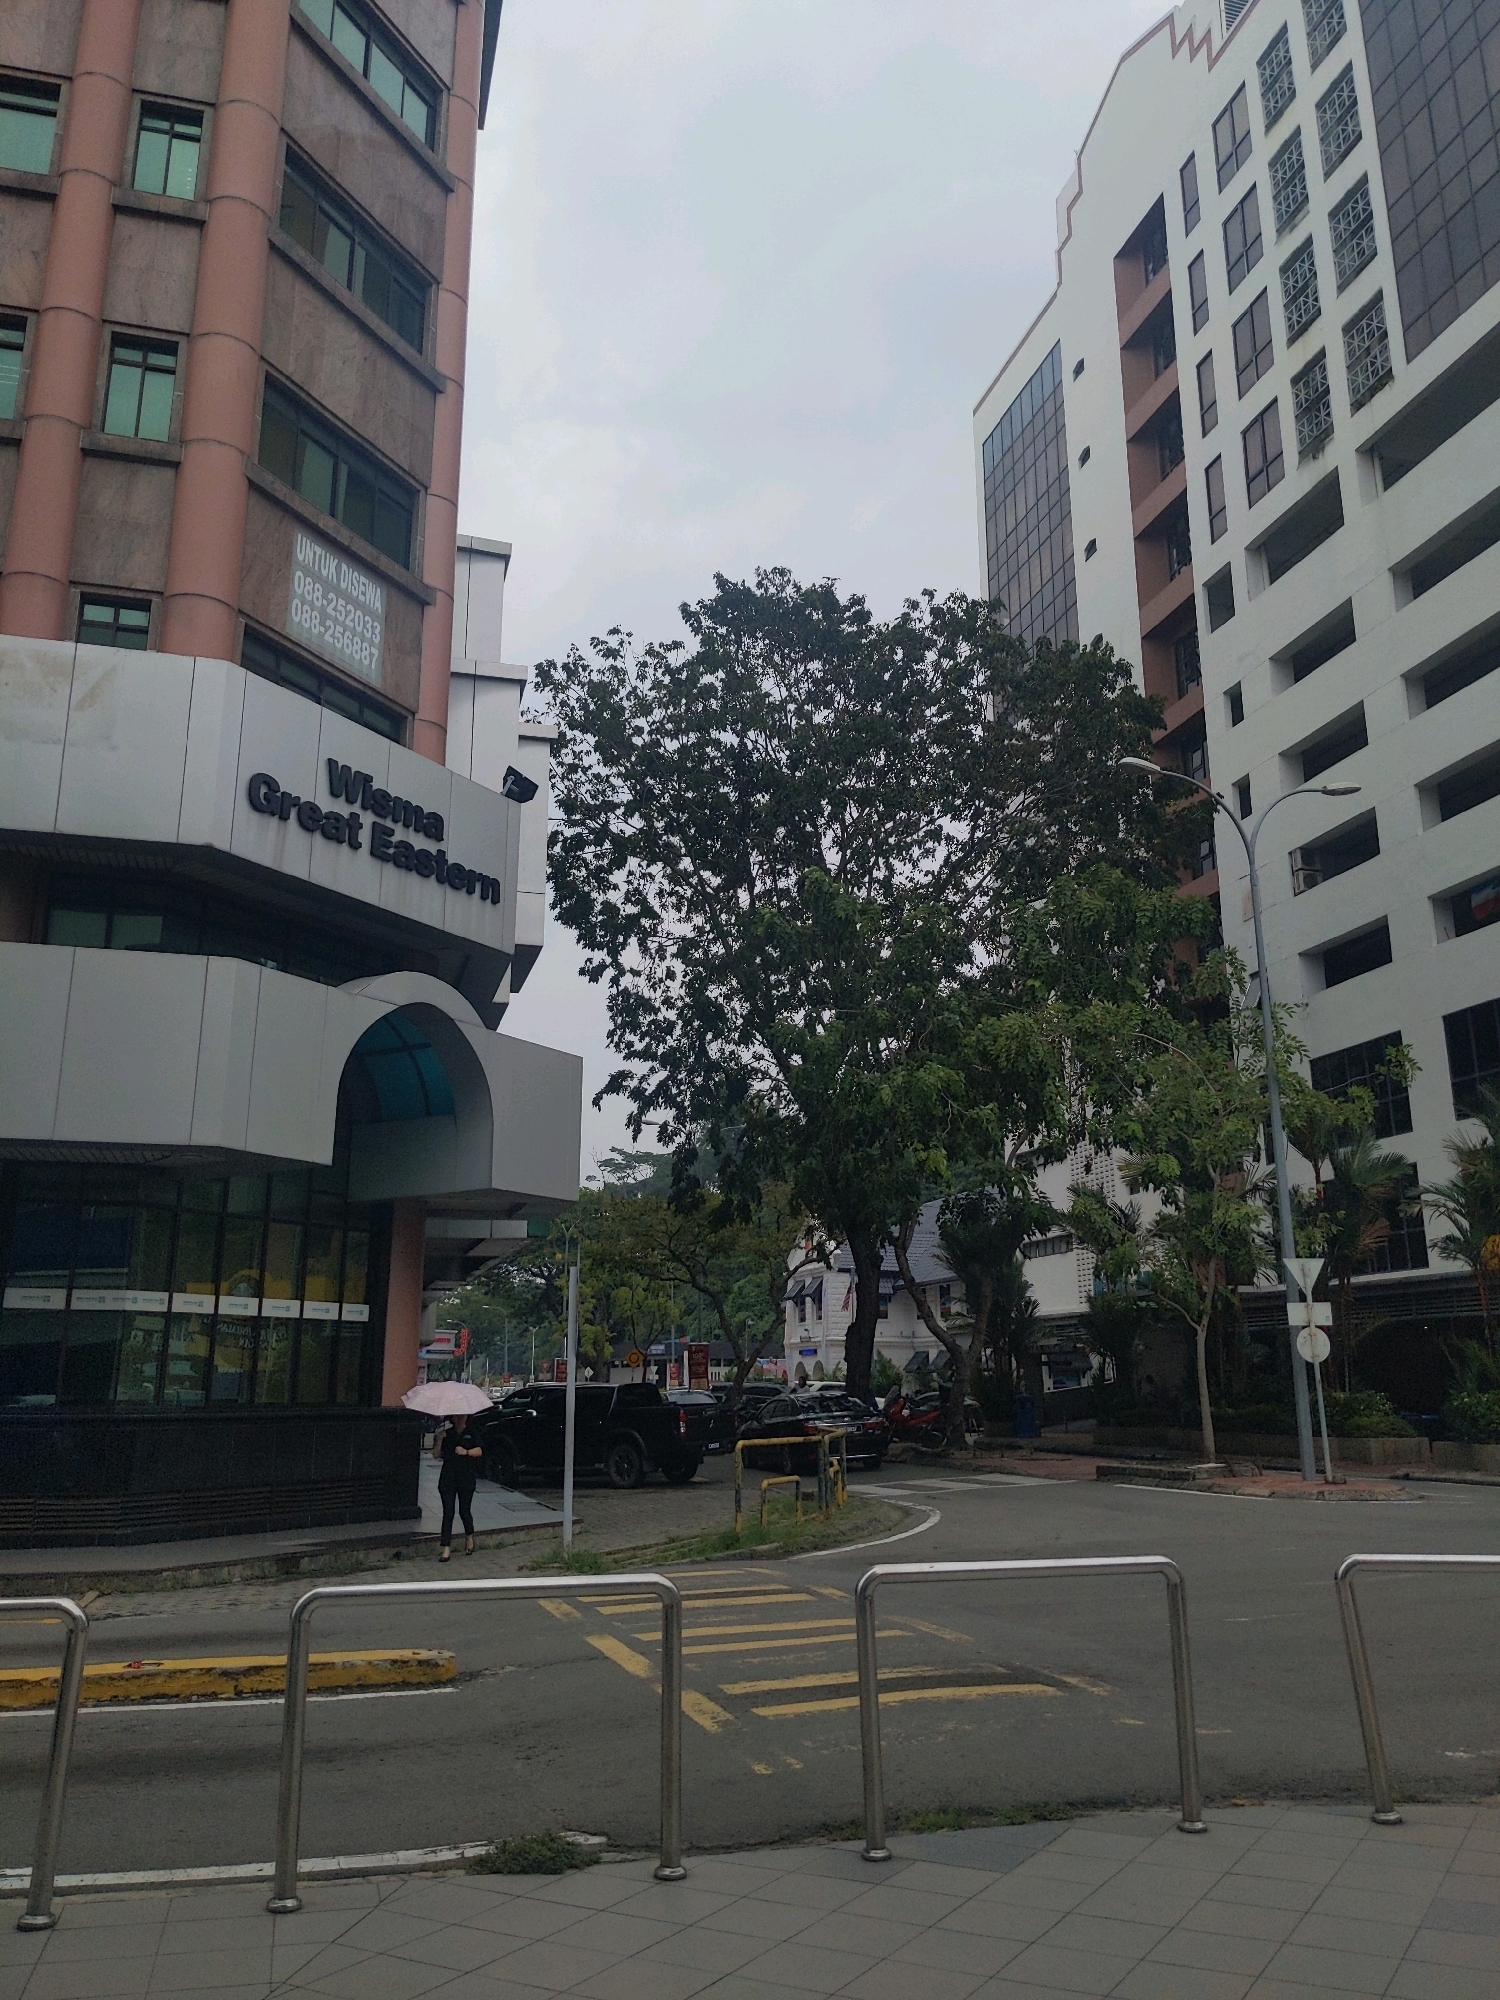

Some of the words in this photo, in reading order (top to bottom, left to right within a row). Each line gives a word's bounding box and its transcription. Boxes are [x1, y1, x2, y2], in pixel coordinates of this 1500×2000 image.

[294, 570, 381, 644] 088-252033
[296, 533, 338, 584] UNTUK
[340, 562, 382, 614] DISEWA
[291, 598, 379, 669] 088-256887
[248, 772, 363, 850] Great
[370, 821, 501, 905] Eastern
[327, 757, 444, 842] Wisma
